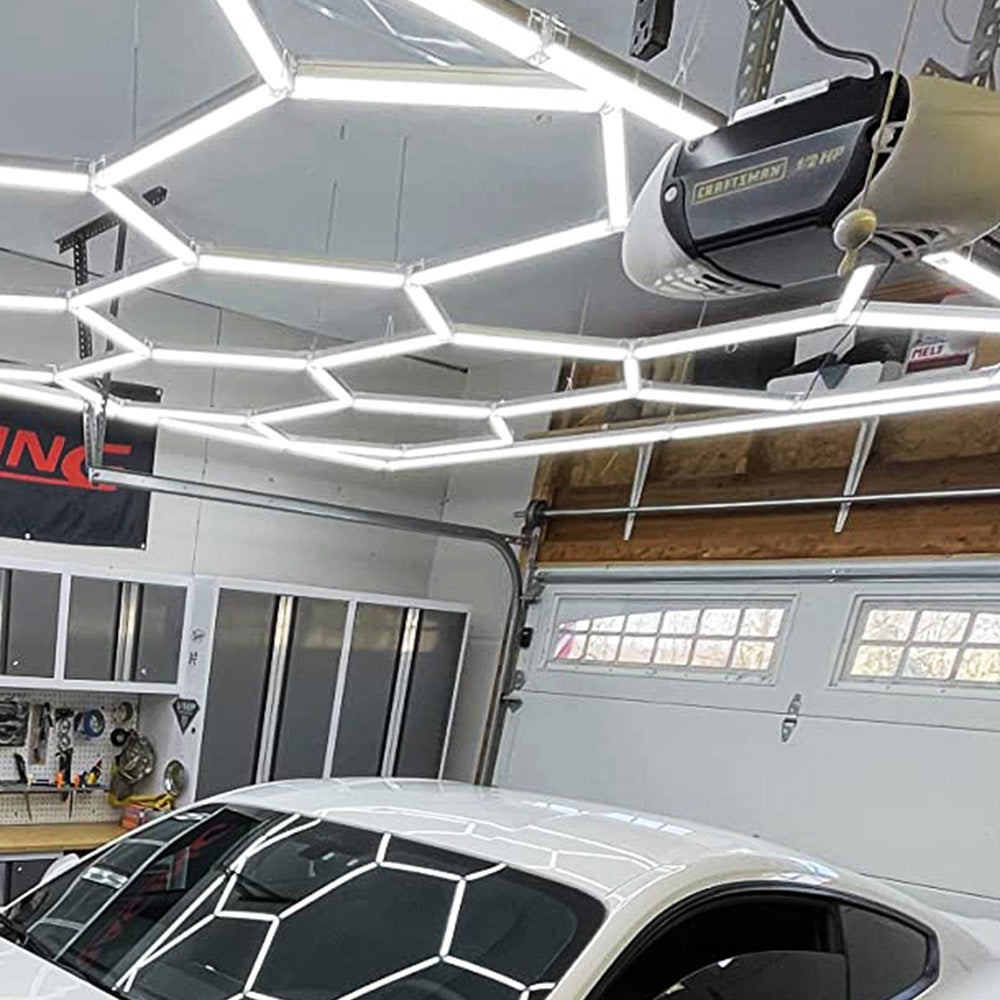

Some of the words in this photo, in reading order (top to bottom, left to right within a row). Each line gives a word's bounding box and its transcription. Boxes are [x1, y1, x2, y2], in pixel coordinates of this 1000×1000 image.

[697, 166, 782, 198] CRAFTSMAN
[818, 145, 846, 166] HP
[912, 344, 944, 359] MELT
